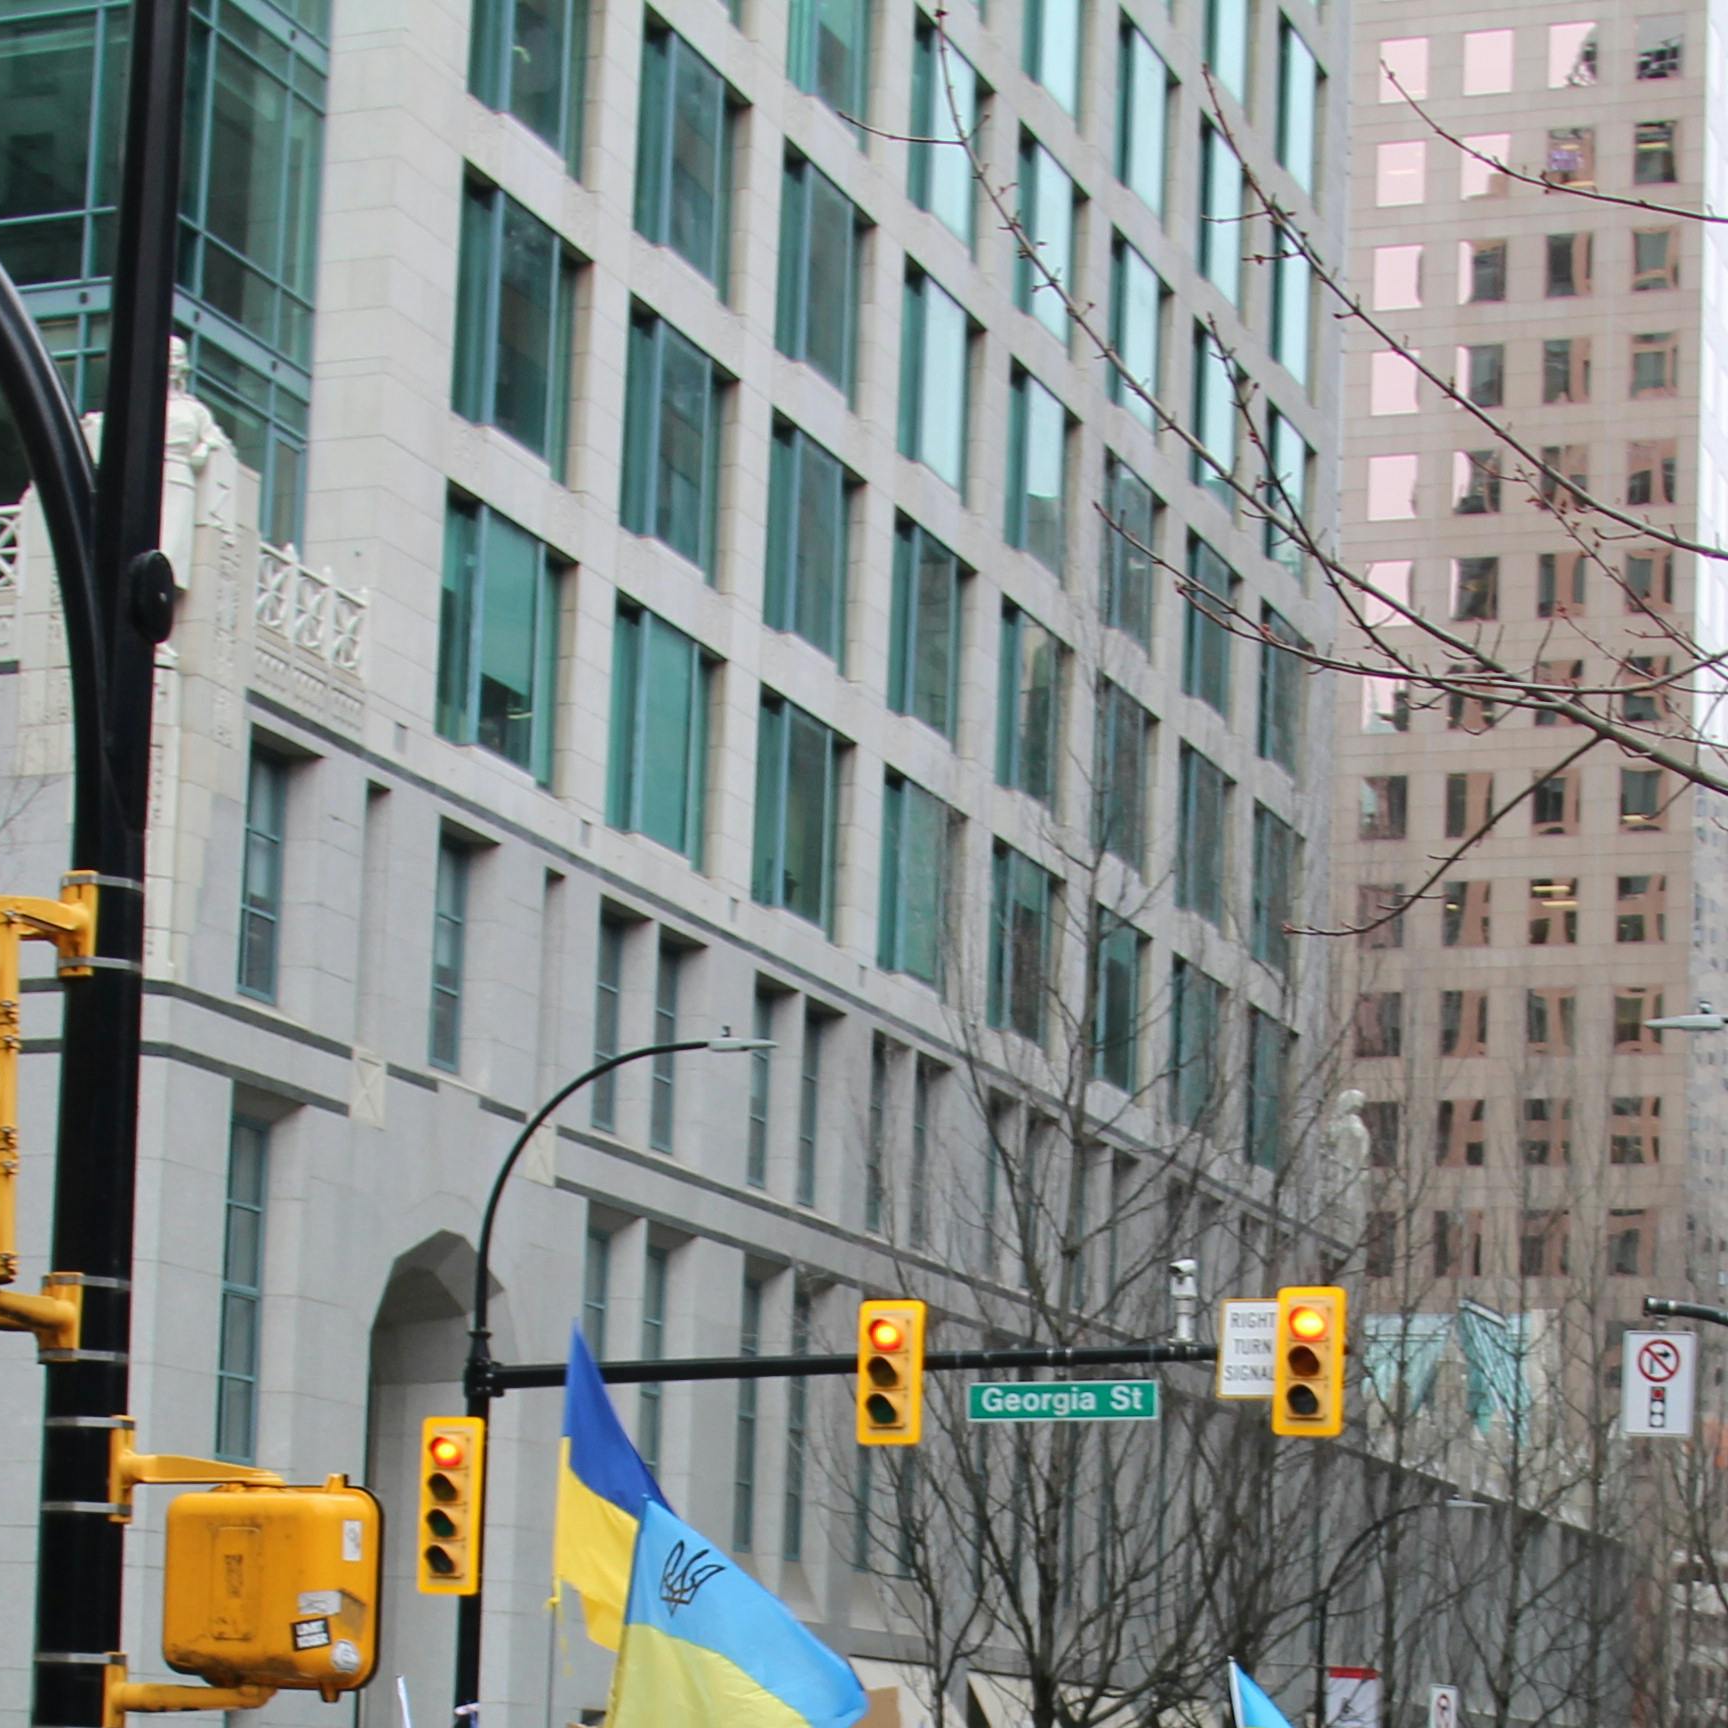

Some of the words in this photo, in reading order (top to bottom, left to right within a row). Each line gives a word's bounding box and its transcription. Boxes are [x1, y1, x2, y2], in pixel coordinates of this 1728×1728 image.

[1230, 1311, 1277, 1328] RIGHT
[1234, 1338, 1272, 1355] TURN
[1224, 1365, 1276, 1381] SIGNAL
[981, 1386, 1096, 1417] Georgia
[1109, 1385, 1144, 1411] St
